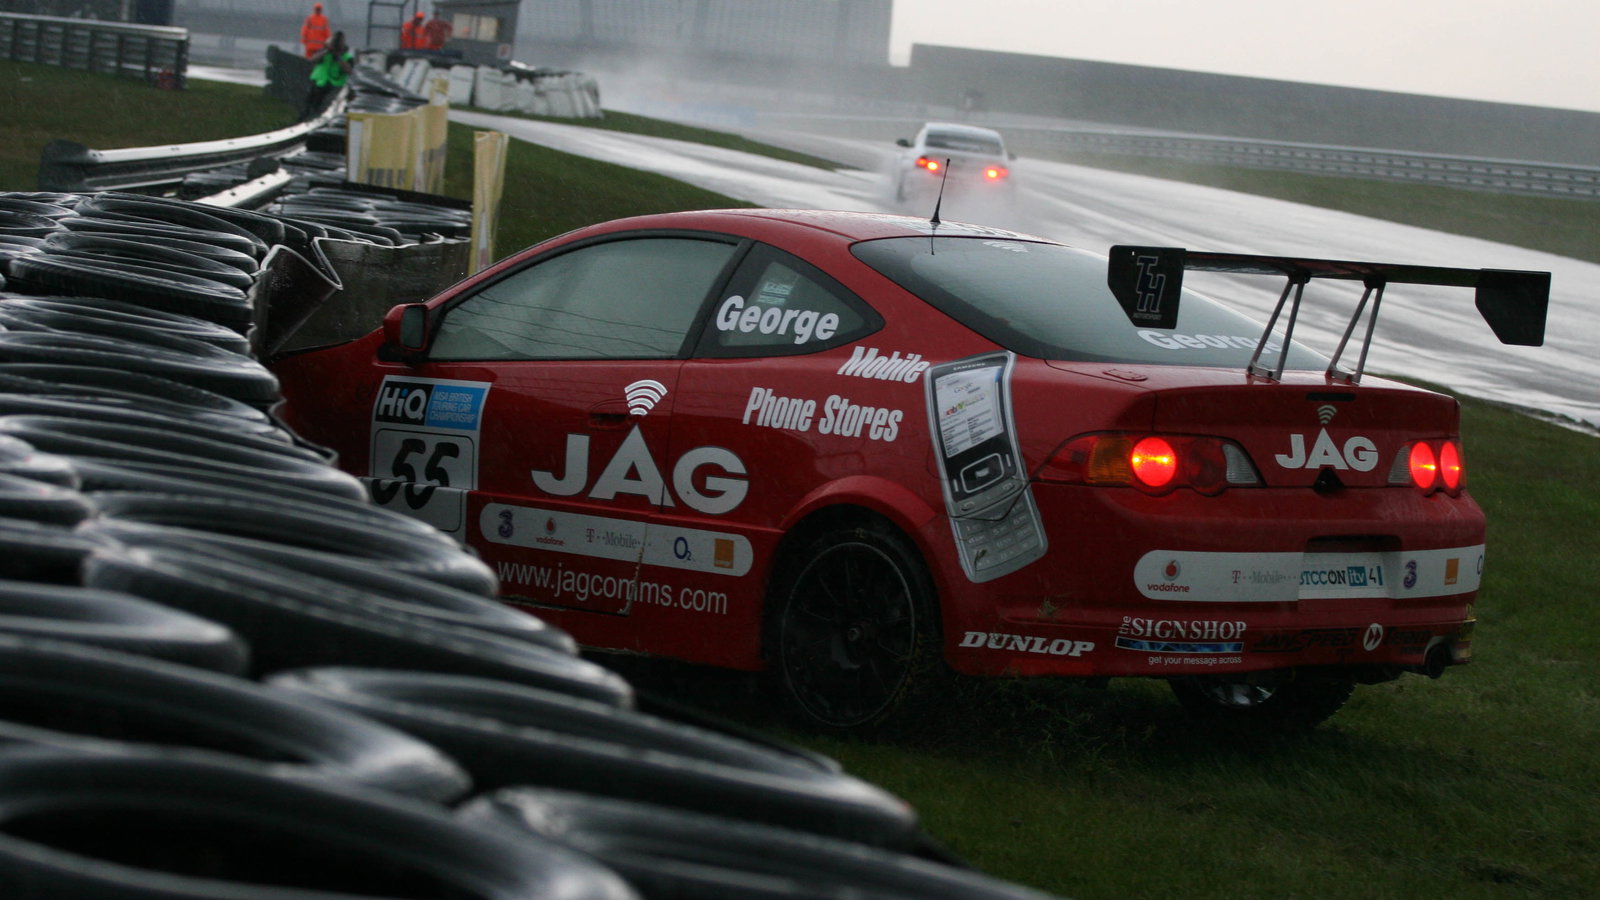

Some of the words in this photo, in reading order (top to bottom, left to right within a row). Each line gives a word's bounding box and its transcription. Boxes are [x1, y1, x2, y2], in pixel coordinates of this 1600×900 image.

[1136, 255, 1166, 313] TH
[716, 295, 839, 345] George
[837, 345, 931, 383] Mobile
[378, 386, 427, 421] HiQ
[742, 386, 816, 432] Phone
[818, 394, 904, 442] Stores
[1274, 426, 1379, 472] JAG
[530, 422, 749, 515] JAG
[535, 535, 564, 546] vodafone
[498, 561, 728, 614] www.jagcomms.com
[1147, 582, 1190, 593] vodafone
[1349, 567, 1366, 584] itv
[1118, 615, 1131, 634] the
[1131, 617, 1188, 638] SIGN
[1191, 619, 1247, 640] SHOP
[958, 631, 1096, 657] DUNLOP
[1148, 654, 1162, 666] get
[1163, 656, 1182, 666] your
[1183, 655, 1218, 666] message
[1219, 655, 1242, 665] across
